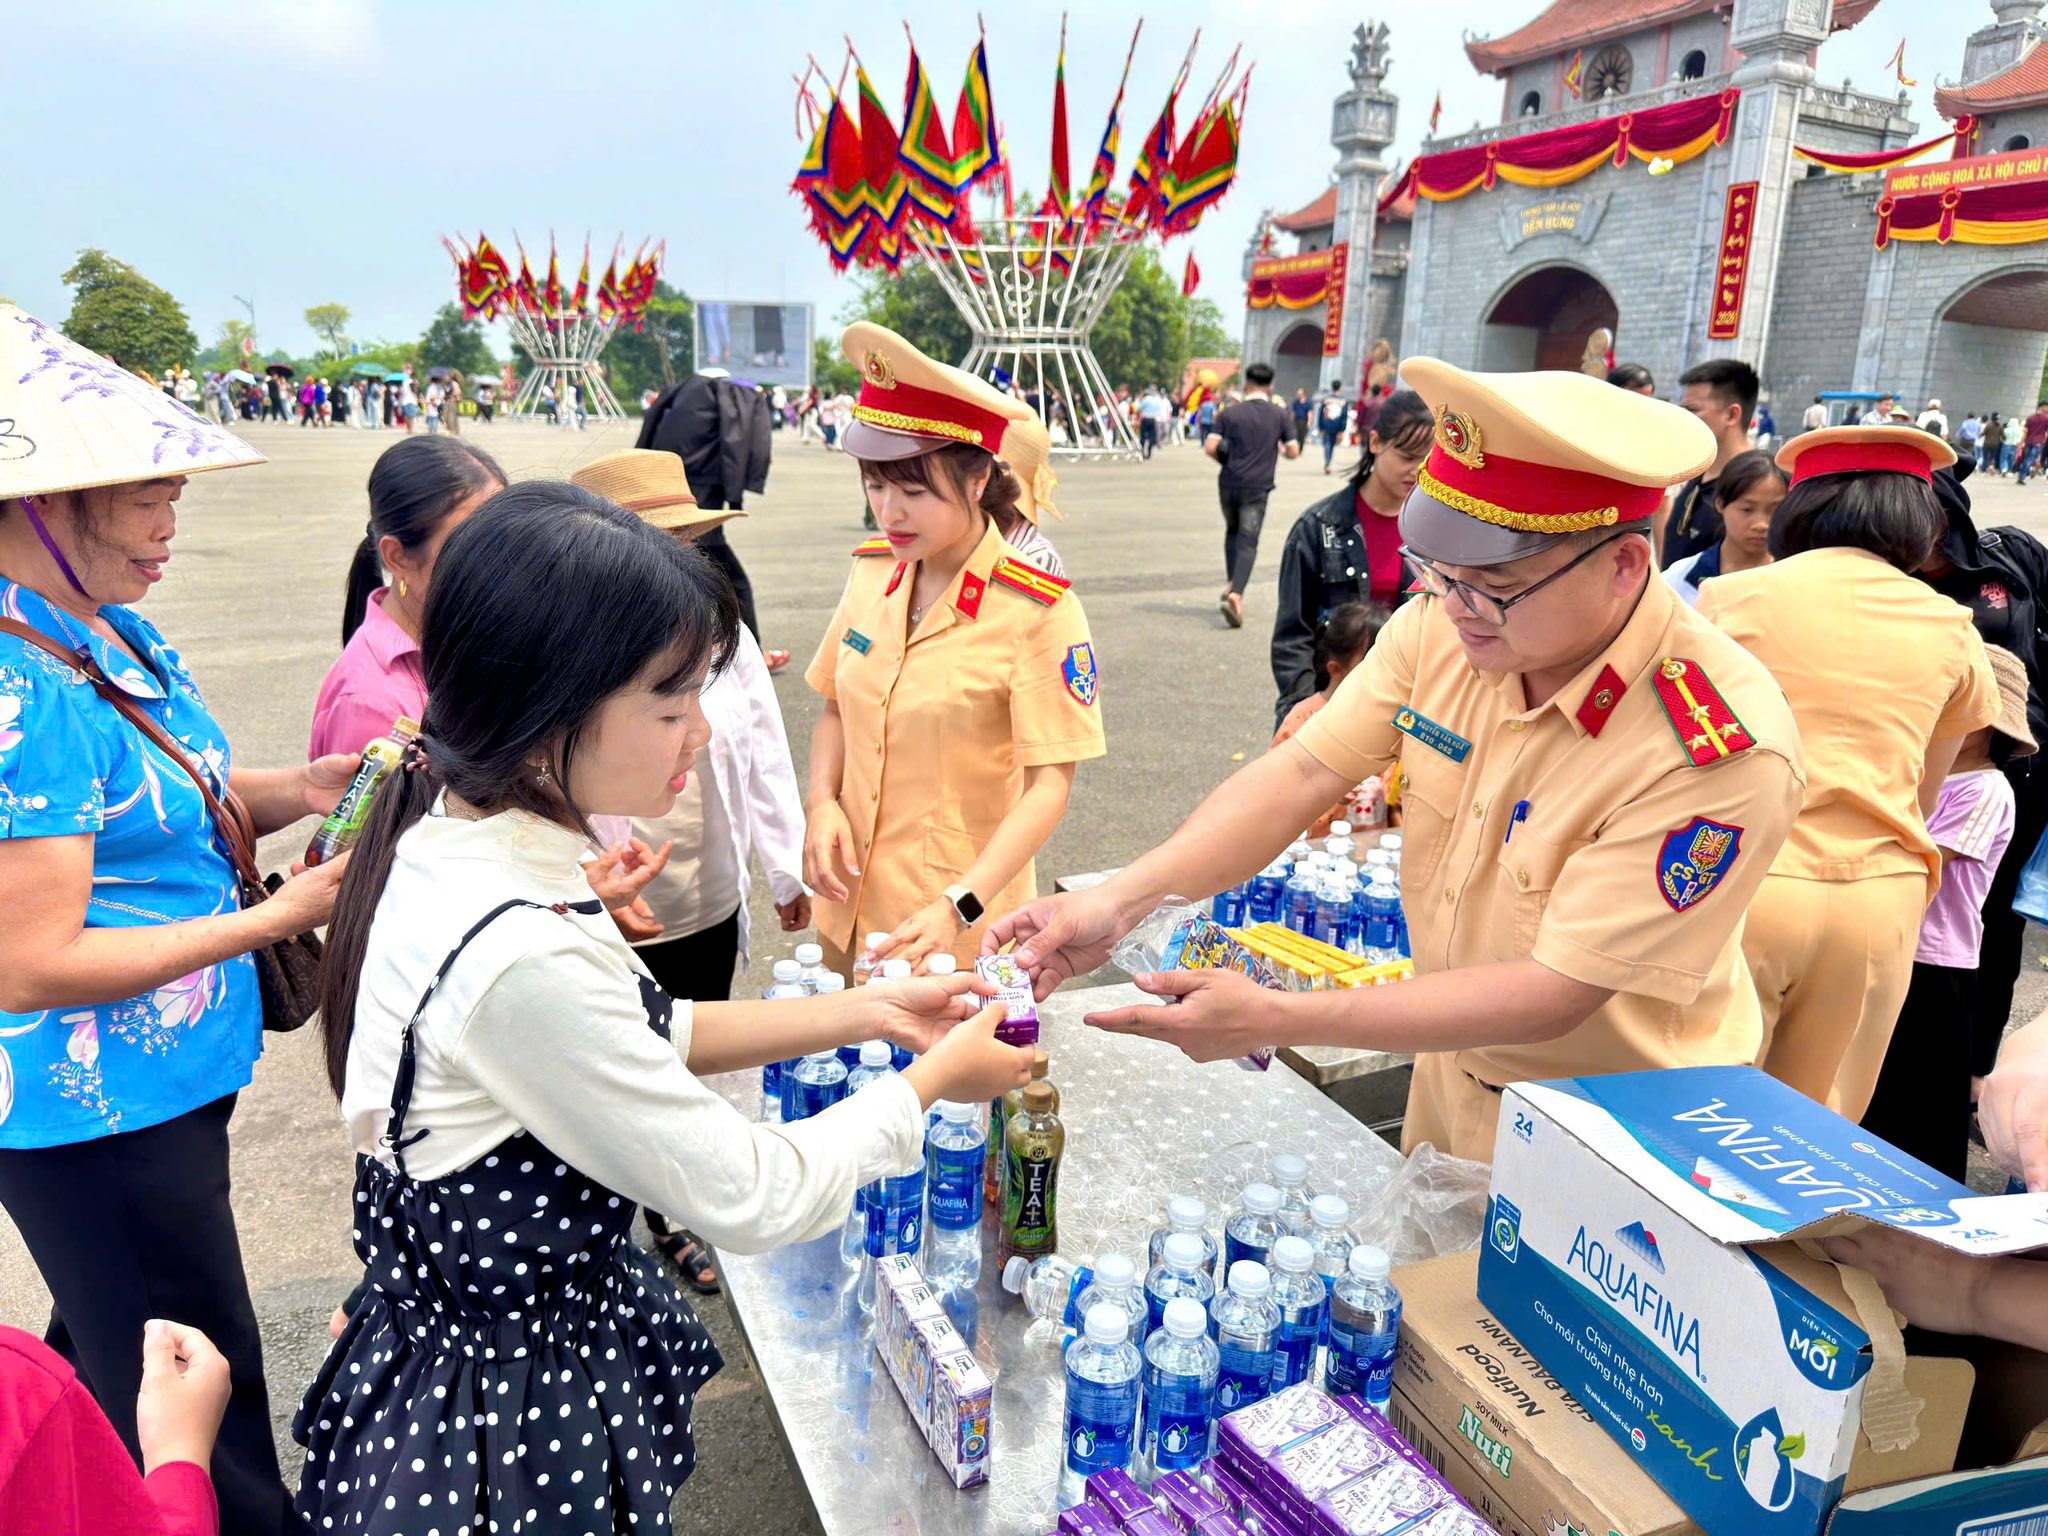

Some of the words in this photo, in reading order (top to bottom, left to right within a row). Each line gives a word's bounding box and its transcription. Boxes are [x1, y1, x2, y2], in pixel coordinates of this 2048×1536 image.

[1891, 173, 1919, 192] NƯỚC
[1921, 170, 1950, 190] CỘNG
[1952, 165, 1975, 184] HOÀ
[1995, 160, 2015, 180] HỘI
[2017, 155, 2041, 175] CHỦ
[1670, 862, 1695, 880] CS
[1699, 872, 1718, 885] GT
[1515, 1112, 1533, 1137] 24
[1672, 1098, 1888, 1213] UAFINA
[930, 1193, 969, 1209] AQUAFINA
[1881, 1186, 1914, 1205] gon
[1567, 1225, 1700, 1378] AQUAFINA
[1475, 1317, 1522, 1357] NÀNH
[1802, 1316, 1820, 1332] DIỆN
[1821, 1330, 1837, 1345] MẠO
[1409, 1343, 1426, 1363] Protein
[1586, 1326, 1611, 1358] Chai
[1614, 1353, 1637, 1382] nhẹ
[1639, 1372, 1663, 1406] hơn
[1369, 1365, 1394, 1382] AQUA
[1456, 1343, 1546, 1418] Nutifood
[1522, 1357, 1563, 1391] ĐẬU
[1534, 1300, 1553, 1325] Cho
[1555, 1322, 1574, 1344] môi
[1576, 1341, 1610, 1381] trường
[1613, 1376, 1644, 1412] thêm
[1646, 1408, 1722, 1480] xanh
[1475, 1401, 1490, 1418] SOY
[1491, 1415, 1509, 1438] MILK
[1457, 1405, 1513, 1479] Nuti
[1472, 1452, 1492, 1474] PURE
